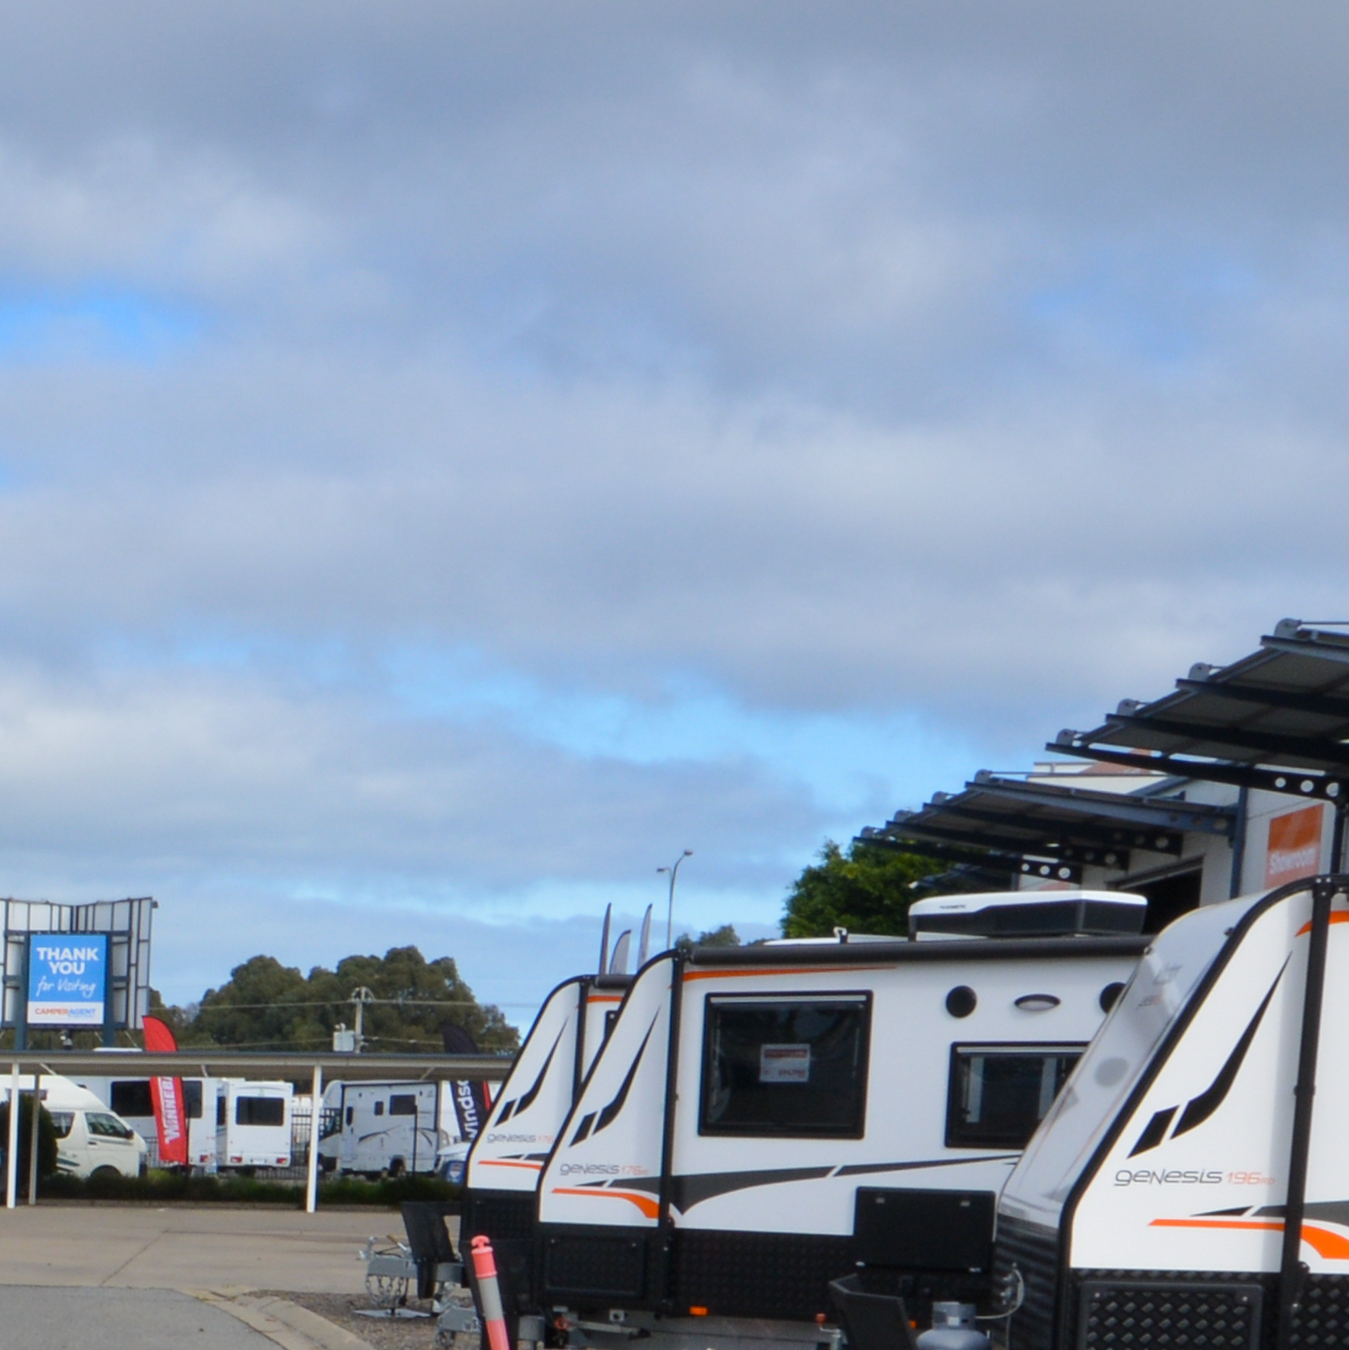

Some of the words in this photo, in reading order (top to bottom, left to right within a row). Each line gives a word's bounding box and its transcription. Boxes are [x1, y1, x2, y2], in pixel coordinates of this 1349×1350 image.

[36, 947, 99, 961] THANK
[48, 961, 86, 975] YOU
[35, 975, 54, 997] for
